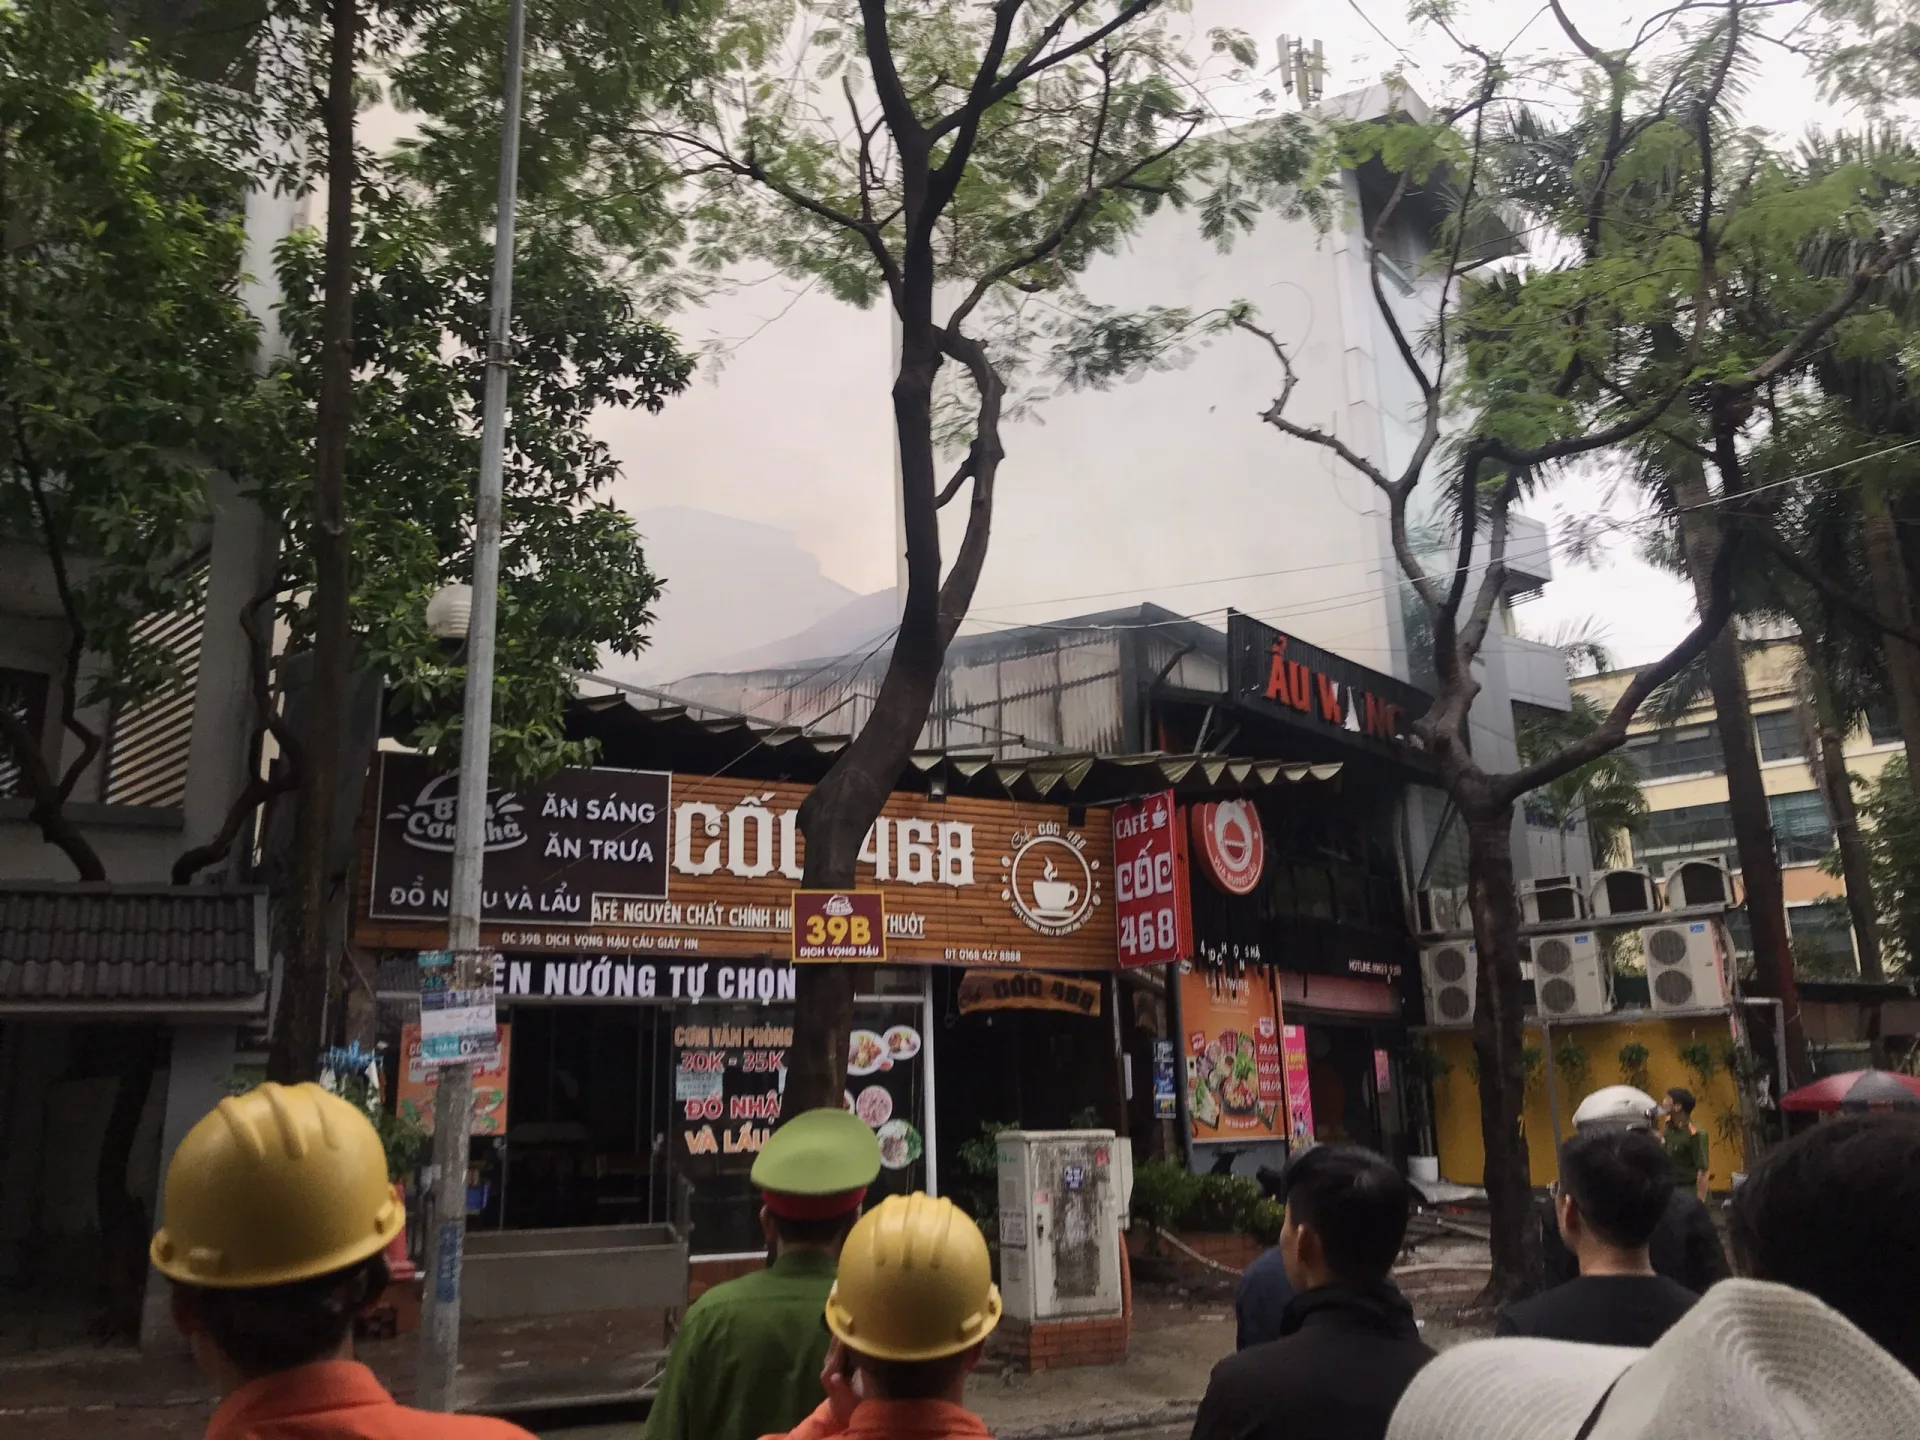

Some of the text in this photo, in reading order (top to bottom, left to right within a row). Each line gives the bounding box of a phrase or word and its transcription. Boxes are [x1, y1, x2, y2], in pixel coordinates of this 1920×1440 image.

[541, 792, 656, 825] ĂN SÁNG
[543, 832, 654, 863] ĂN TRƯA
[856, 816, 976, 887] 468
[1116, 838, 1173, 903] CỐC
[389, 874, 425, 908] ĐỒ
[504, 885, 533, 911] VÀ
[540, 881, 581, 914] LẨU
[623, 899, 682, 925] NGUYÊN
[686, 899, 723, 927] CHẤT
[728, 902, 770, 930] CHÍNH
[806, 914, 871, 945] 39B
[519, 932, 541, 946] 39B
[683, 938, 699, 950] HN
[1120, 908, 1174, 956] 468
[544, 954, 657, 998] NƯỚNG
[668, 962, 709, 1005] TỰ
[717, 966, 797, 1006] CHỌN
[674, 1021, 794, 1048] CƠM VĂN PHÒNG
[680, 1050, 725, 1073] 30K
[742, 1050, 785, 1073] 35K
[729, 1088, 782, 1125] NHẬ
[684, 1124, 719, 1155] VÀ
